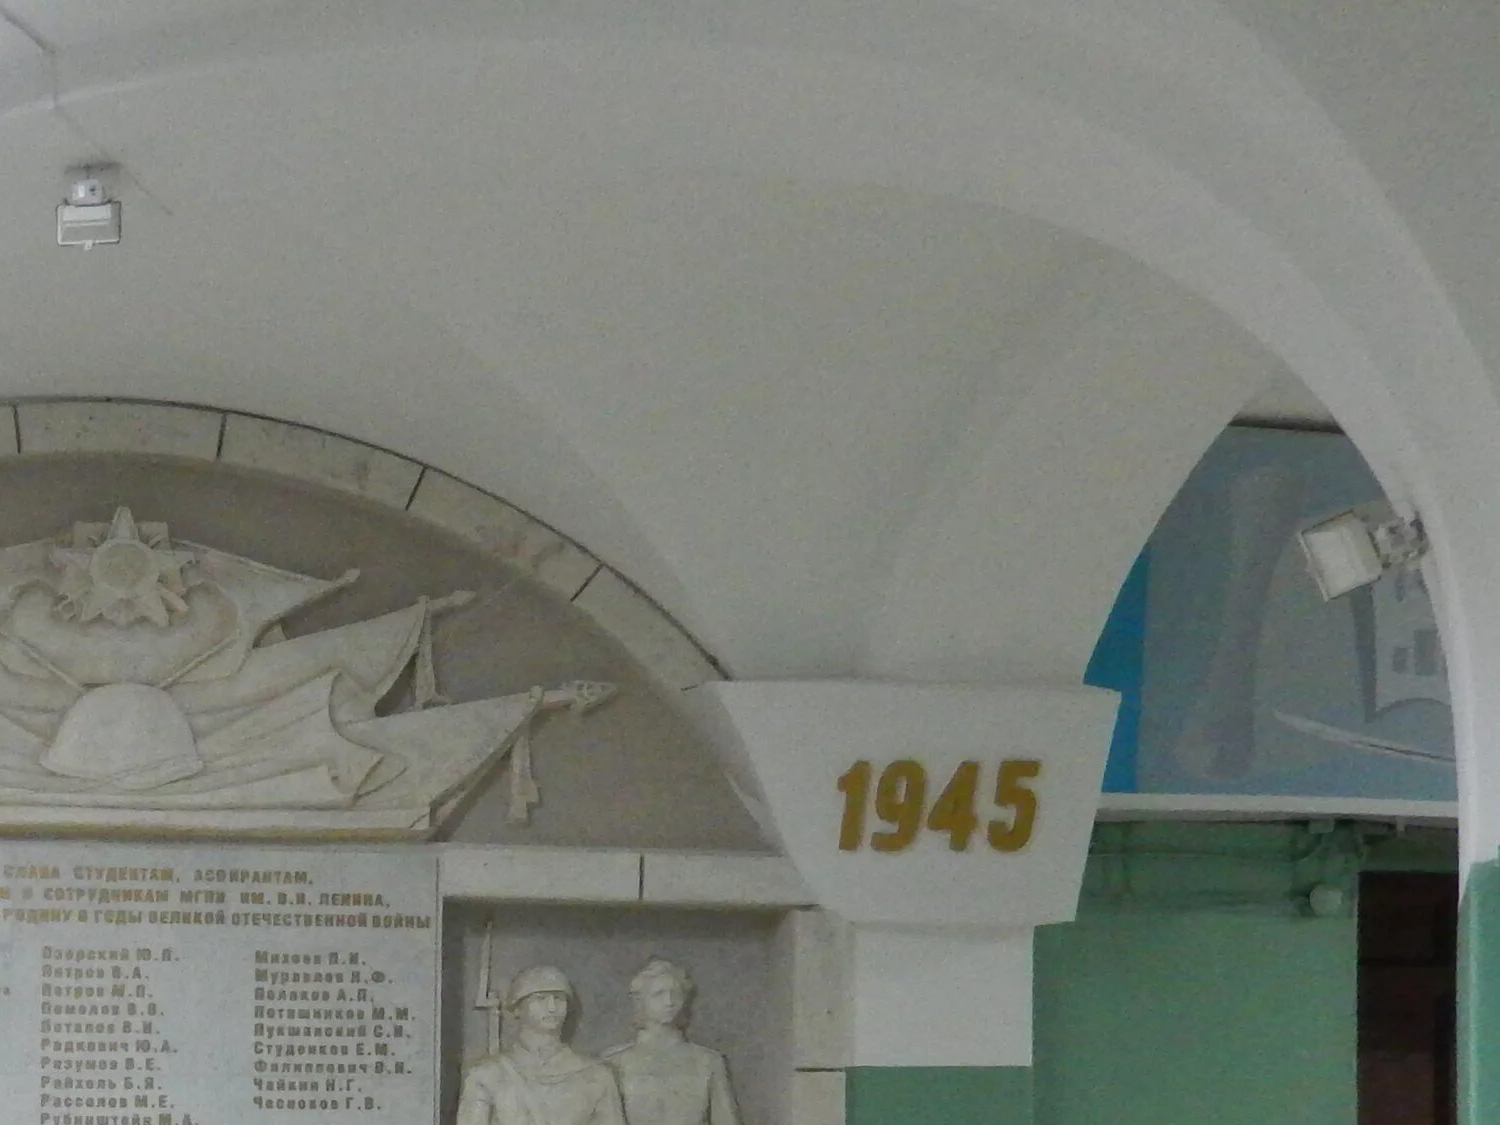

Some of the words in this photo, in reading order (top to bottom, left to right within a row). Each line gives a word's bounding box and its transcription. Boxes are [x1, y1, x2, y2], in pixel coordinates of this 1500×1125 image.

[837, 758, 1041, 852] 1945
[2, 909, 73, 924] РОДИНУ
[92, 910, 143, 925] ГОДЫ
[147, 910, 226, 925] ВЕЛИКОЙ
[231, 913, 367, 927] ОТЕЧЕСТВЕННОЙ
[372, 914, 432, 928] ВОЙНЫ
